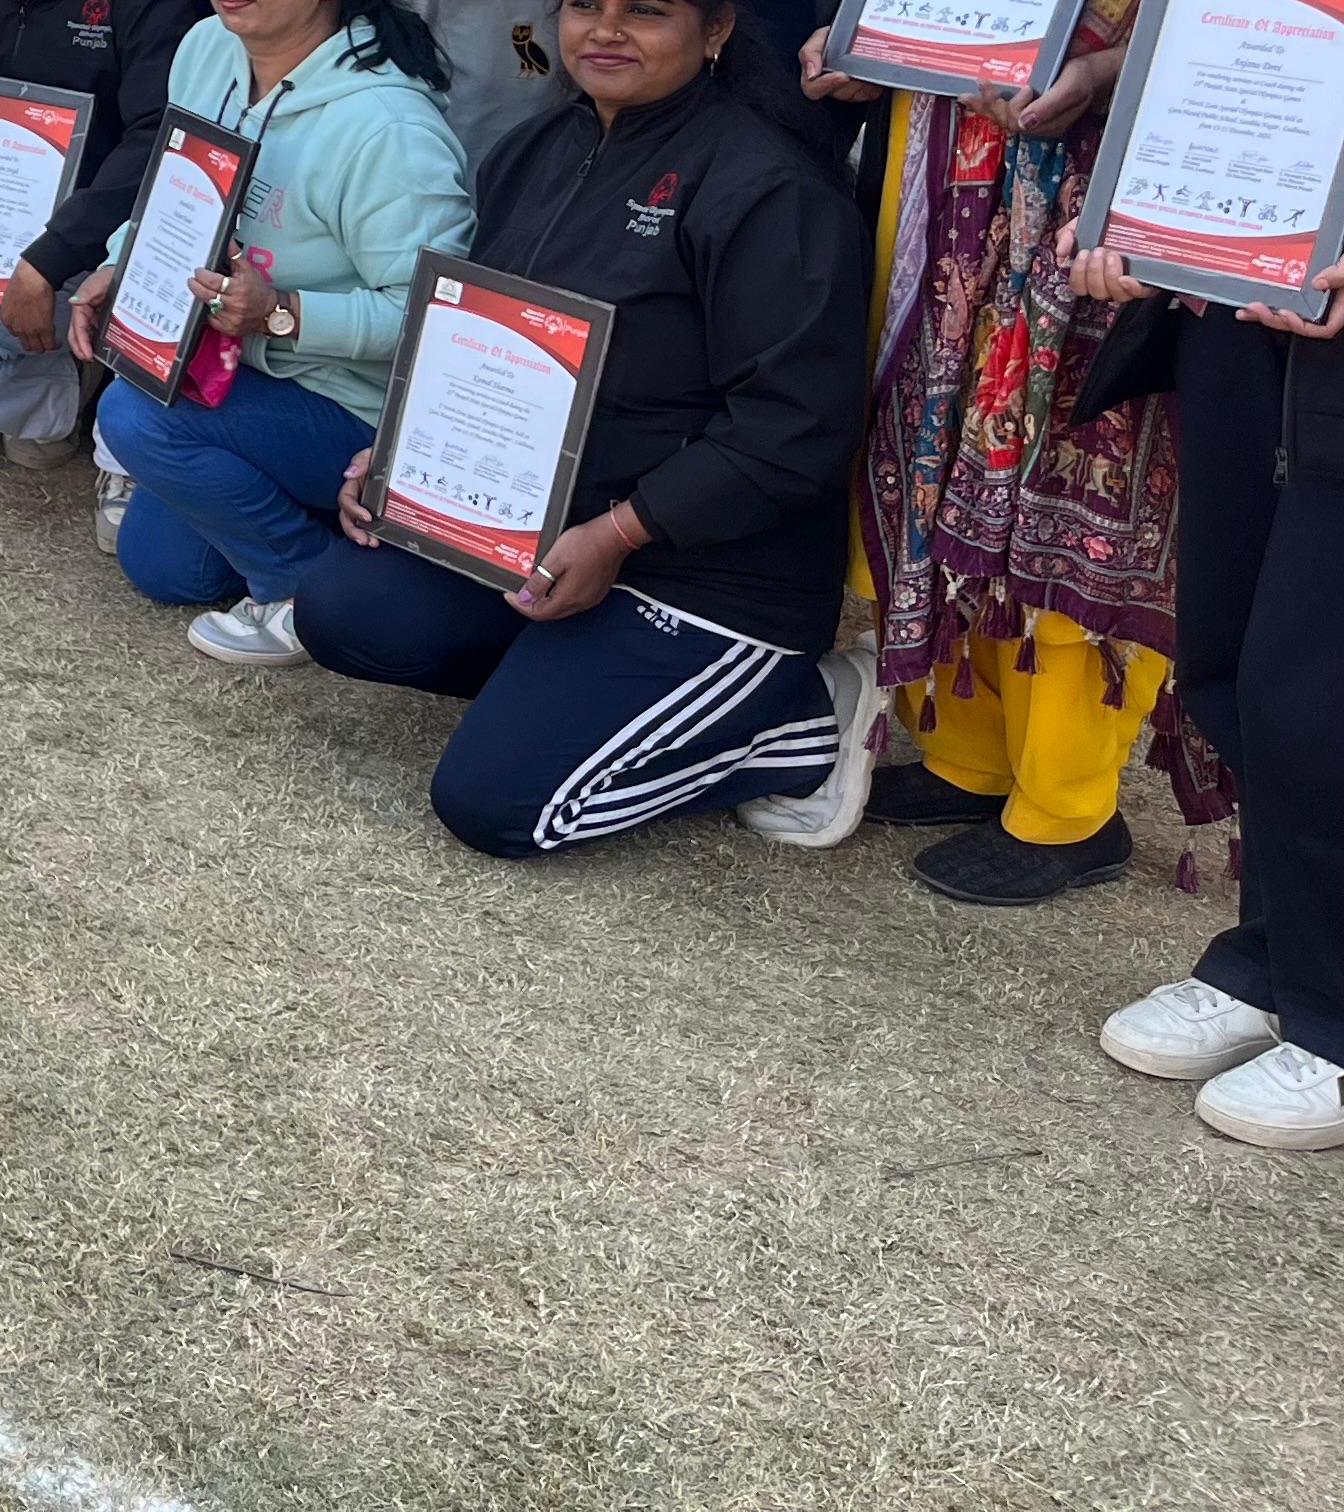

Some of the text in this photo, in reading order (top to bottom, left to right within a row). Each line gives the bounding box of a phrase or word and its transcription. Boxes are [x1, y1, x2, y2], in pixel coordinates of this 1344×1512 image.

[1201, 10, 1337, 41] Certificate Of Appreciation
[451, 334, 489, 353] Certificate
[491, 346, 502, 357] Of
